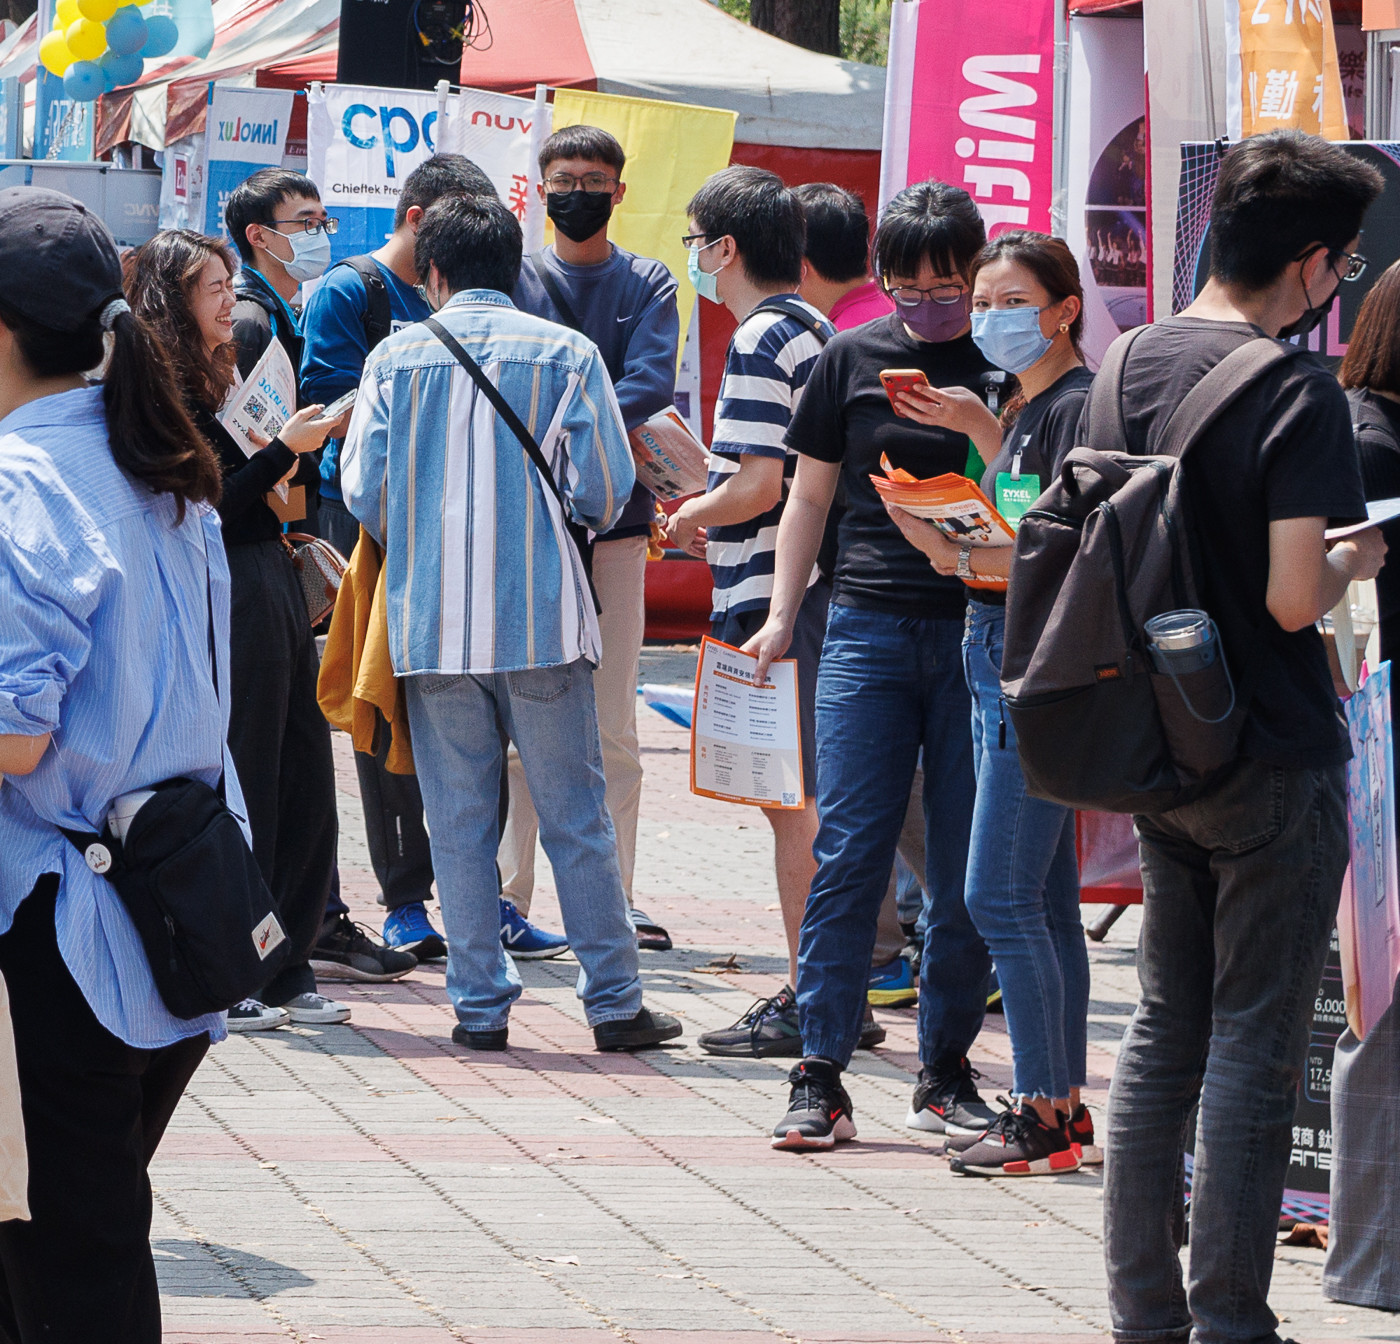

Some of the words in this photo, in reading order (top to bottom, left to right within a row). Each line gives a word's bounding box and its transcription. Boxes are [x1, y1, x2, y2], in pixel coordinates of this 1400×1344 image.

[332, 183, 381, 196] Chieftek
[258, 377, 282, 406] JOIN
[641, 432, 665, 457] JOIN
[1003, 488, 1031, 499] ZYXEL
